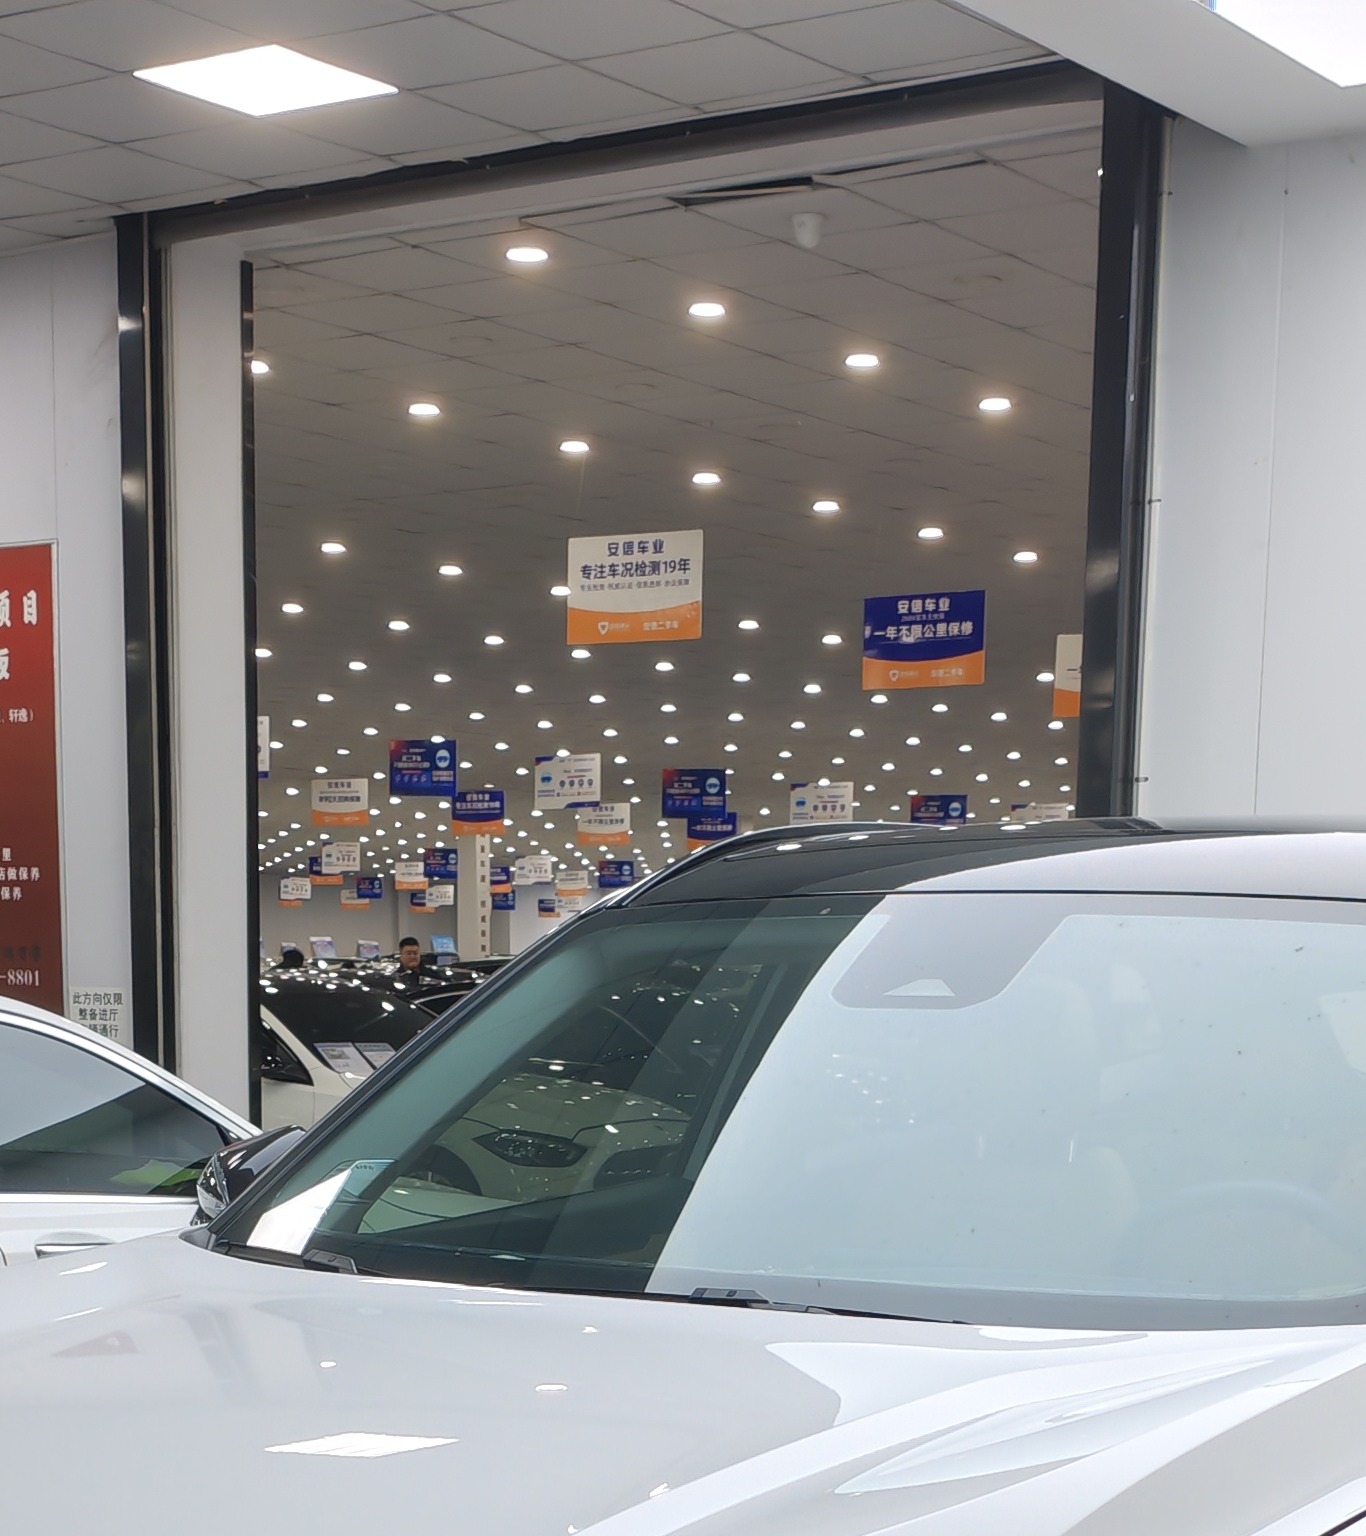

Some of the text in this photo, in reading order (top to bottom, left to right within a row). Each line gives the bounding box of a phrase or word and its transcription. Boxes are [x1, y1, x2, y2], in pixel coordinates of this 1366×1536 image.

[580, 558, 691, 580] 专注车况检测19年
[72, 992, 123, 1006] 此方向仅限
[78, 1008, 119, 1022] 整备进厅
[82, 1023, 119, 1038] 辆通行
